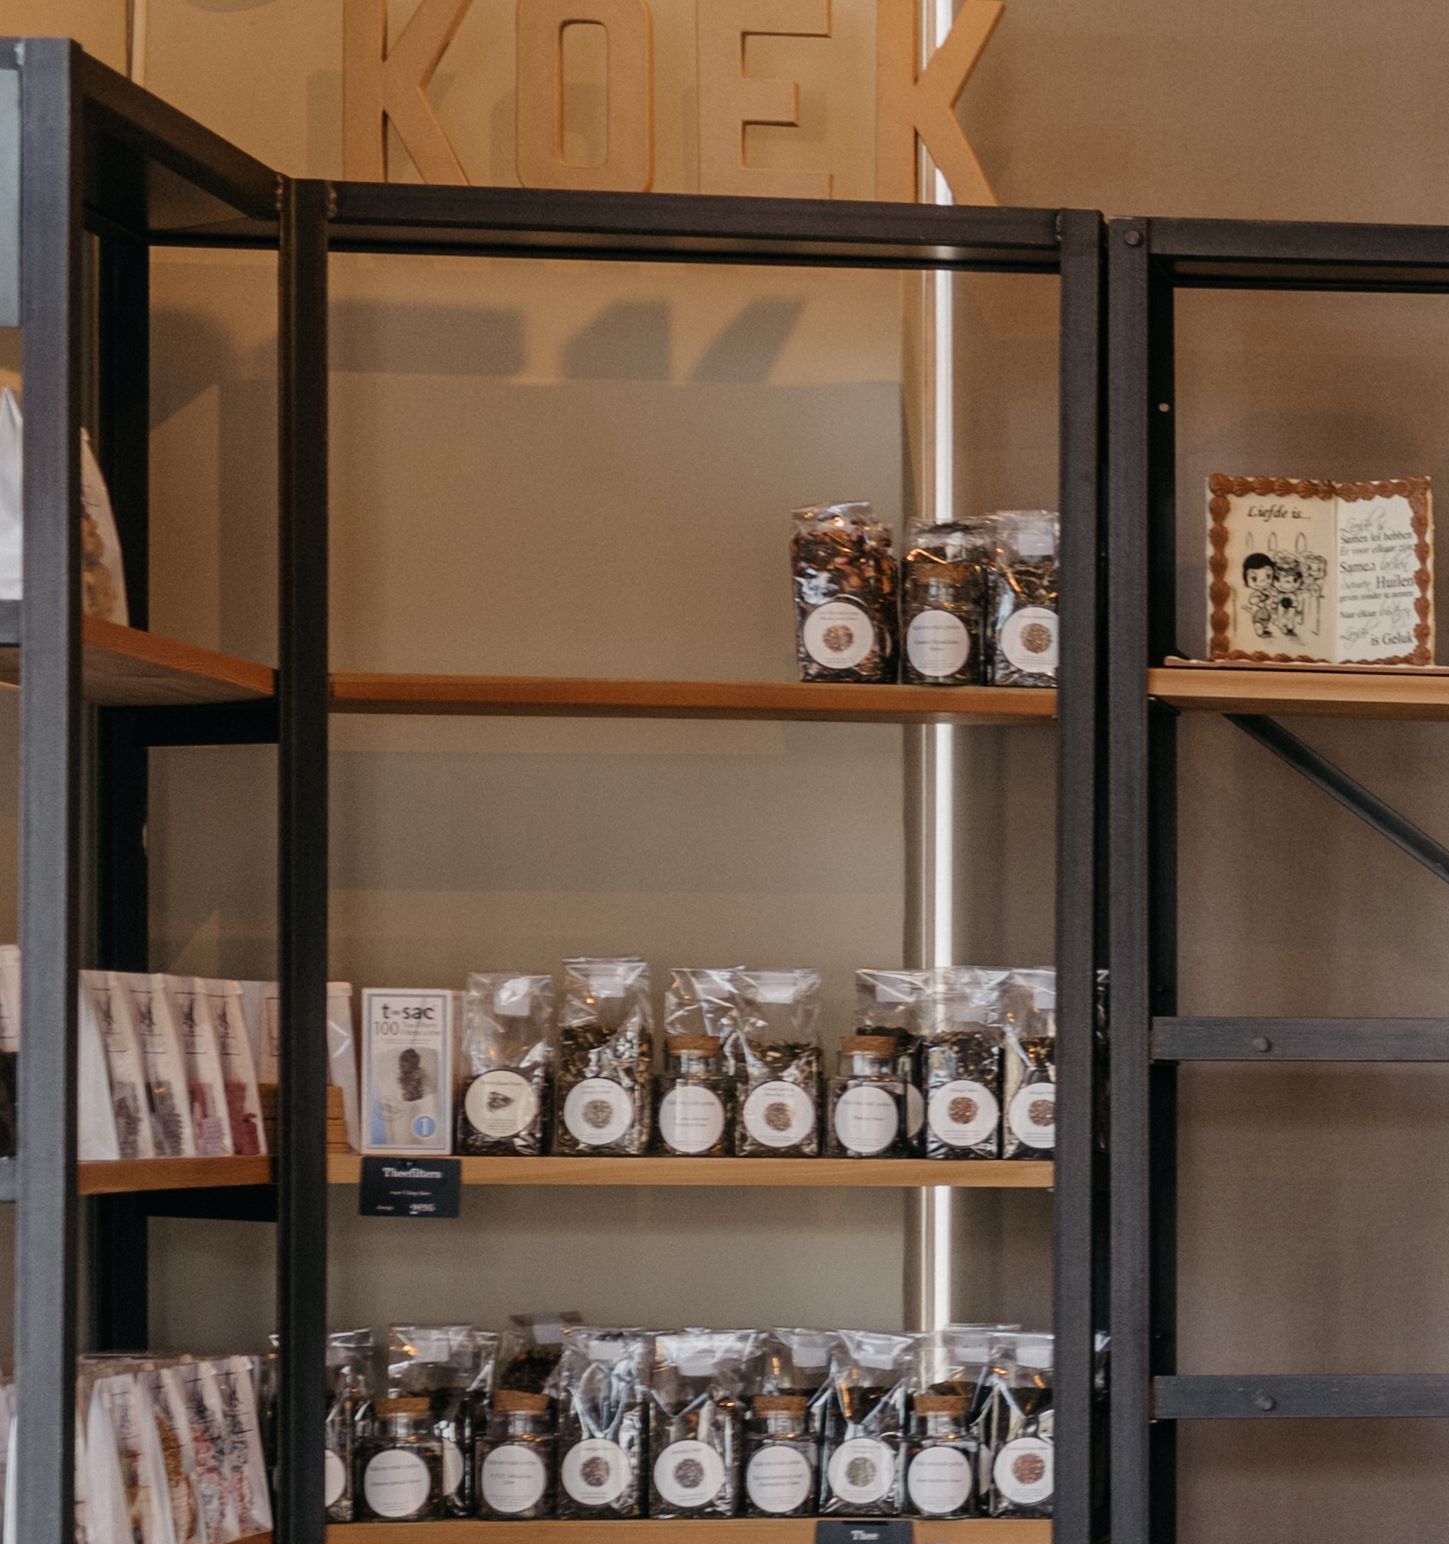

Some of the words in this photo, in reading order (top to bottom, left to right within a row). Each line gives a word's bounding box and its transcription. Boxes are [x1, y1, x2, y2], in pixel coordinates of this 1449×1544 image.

[342, 0, 1005, 206] KOEK
[1247, 505, 1288, 521] Liefde
[1376, 575, 1414, 589] Huilen
[381, 1003, 435, 1021] t-sac
[373, 1021, 399, 1036] 100
